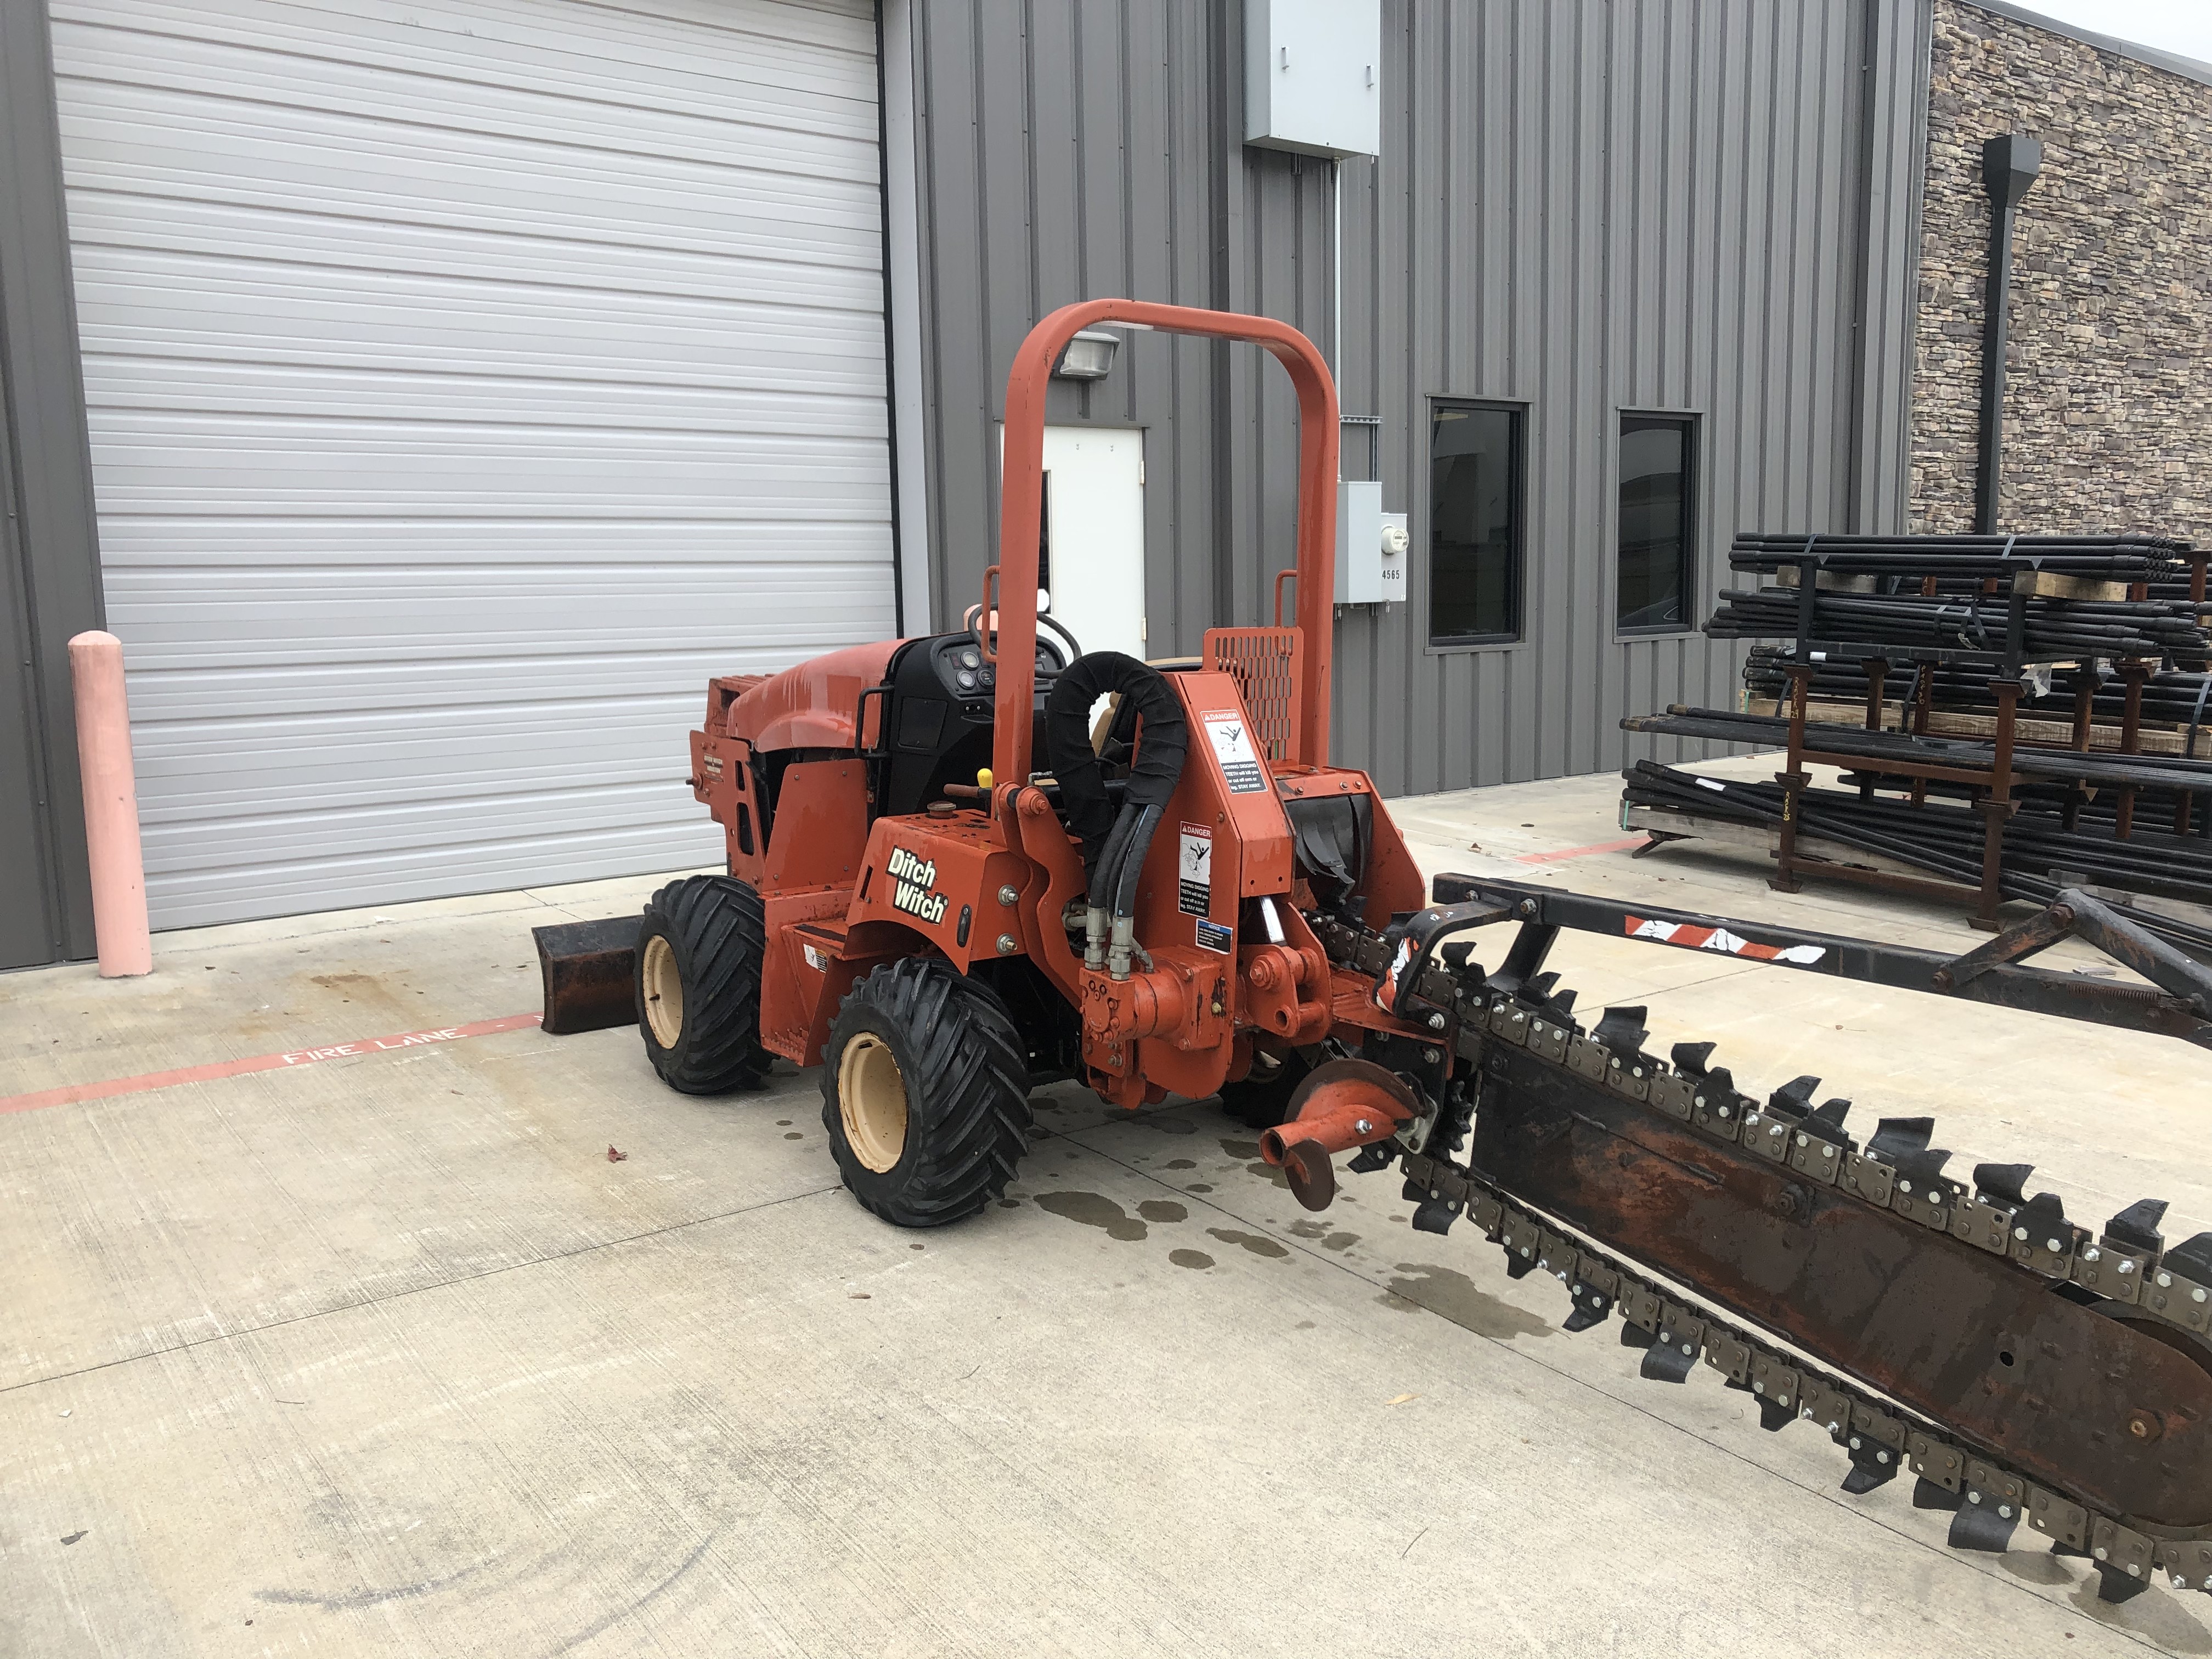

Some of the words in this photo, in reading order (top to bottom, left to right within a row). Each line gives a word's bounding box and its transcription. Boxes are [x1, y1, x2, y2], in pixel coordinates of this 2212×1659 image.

[1382, 569, 1400, 579] 4565
[1187, 827, 1210, 837] DANGER
[888, 848, 935, 888] Ditch
[281, 1044, 363, 1064] FIRE
[374, 1028, 467, 1049] LANE
